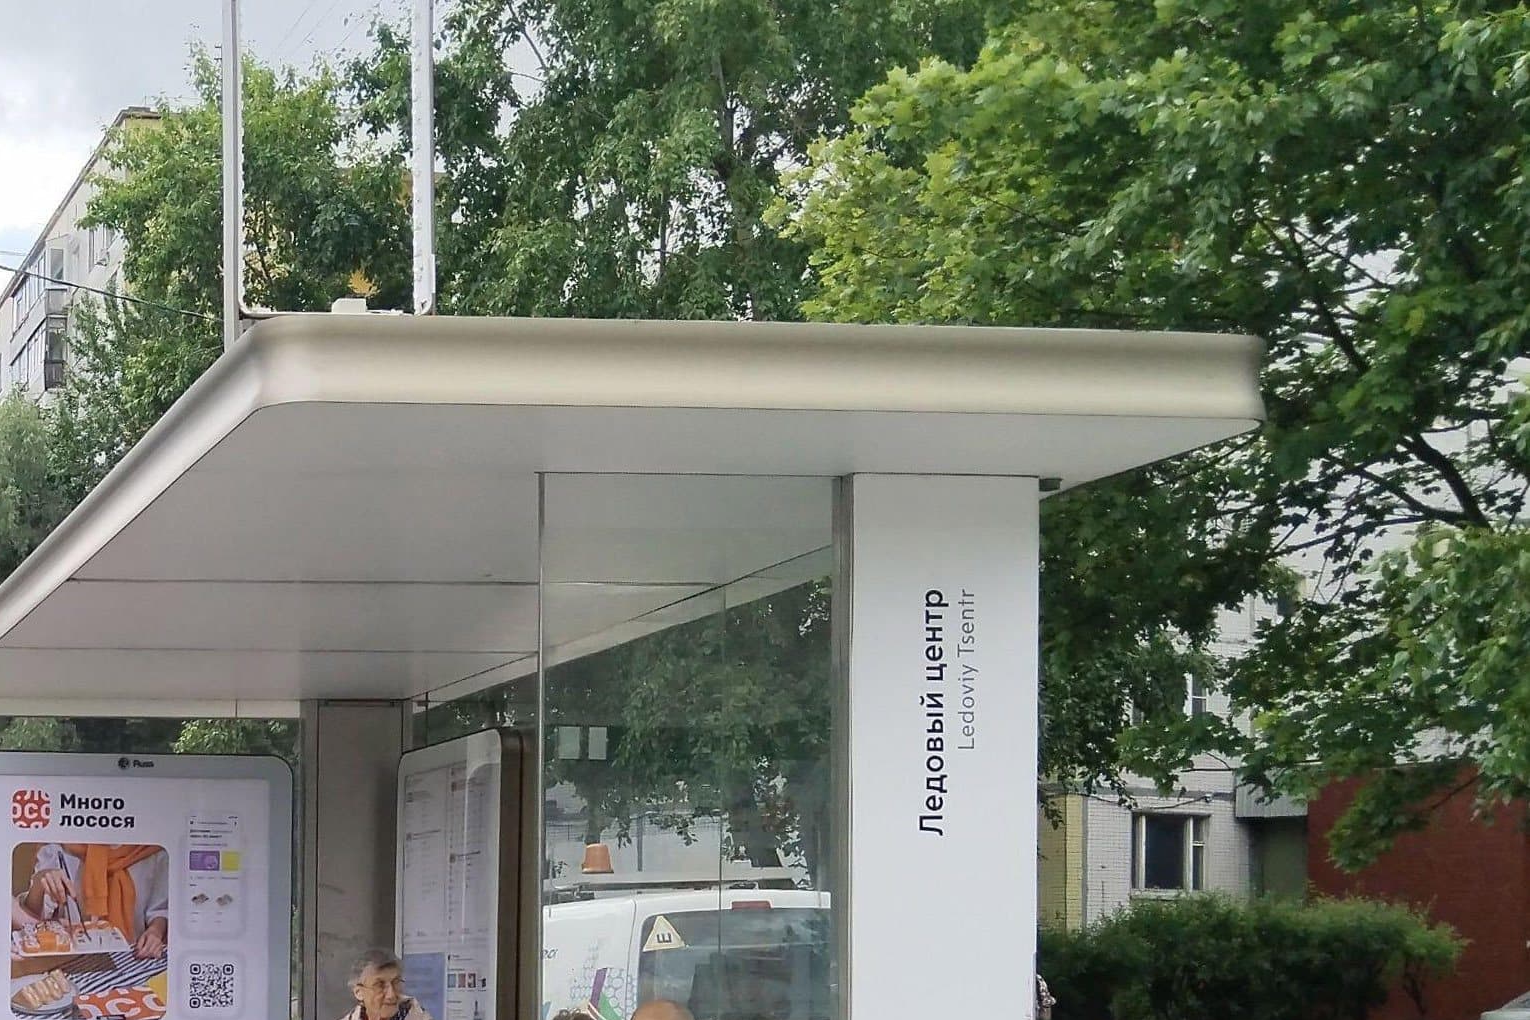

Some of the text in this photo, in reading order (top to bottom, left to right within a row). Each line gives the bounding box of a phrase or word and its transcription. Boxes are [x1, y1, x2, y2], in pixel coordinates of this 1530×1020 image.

[919, 588, 949, 836] Ледовый центр
[957, 588, 979, 750] Ledoviy Tsentr
[59, 815, 135, 828] лосося
[60, 793, 125, 810] Много
